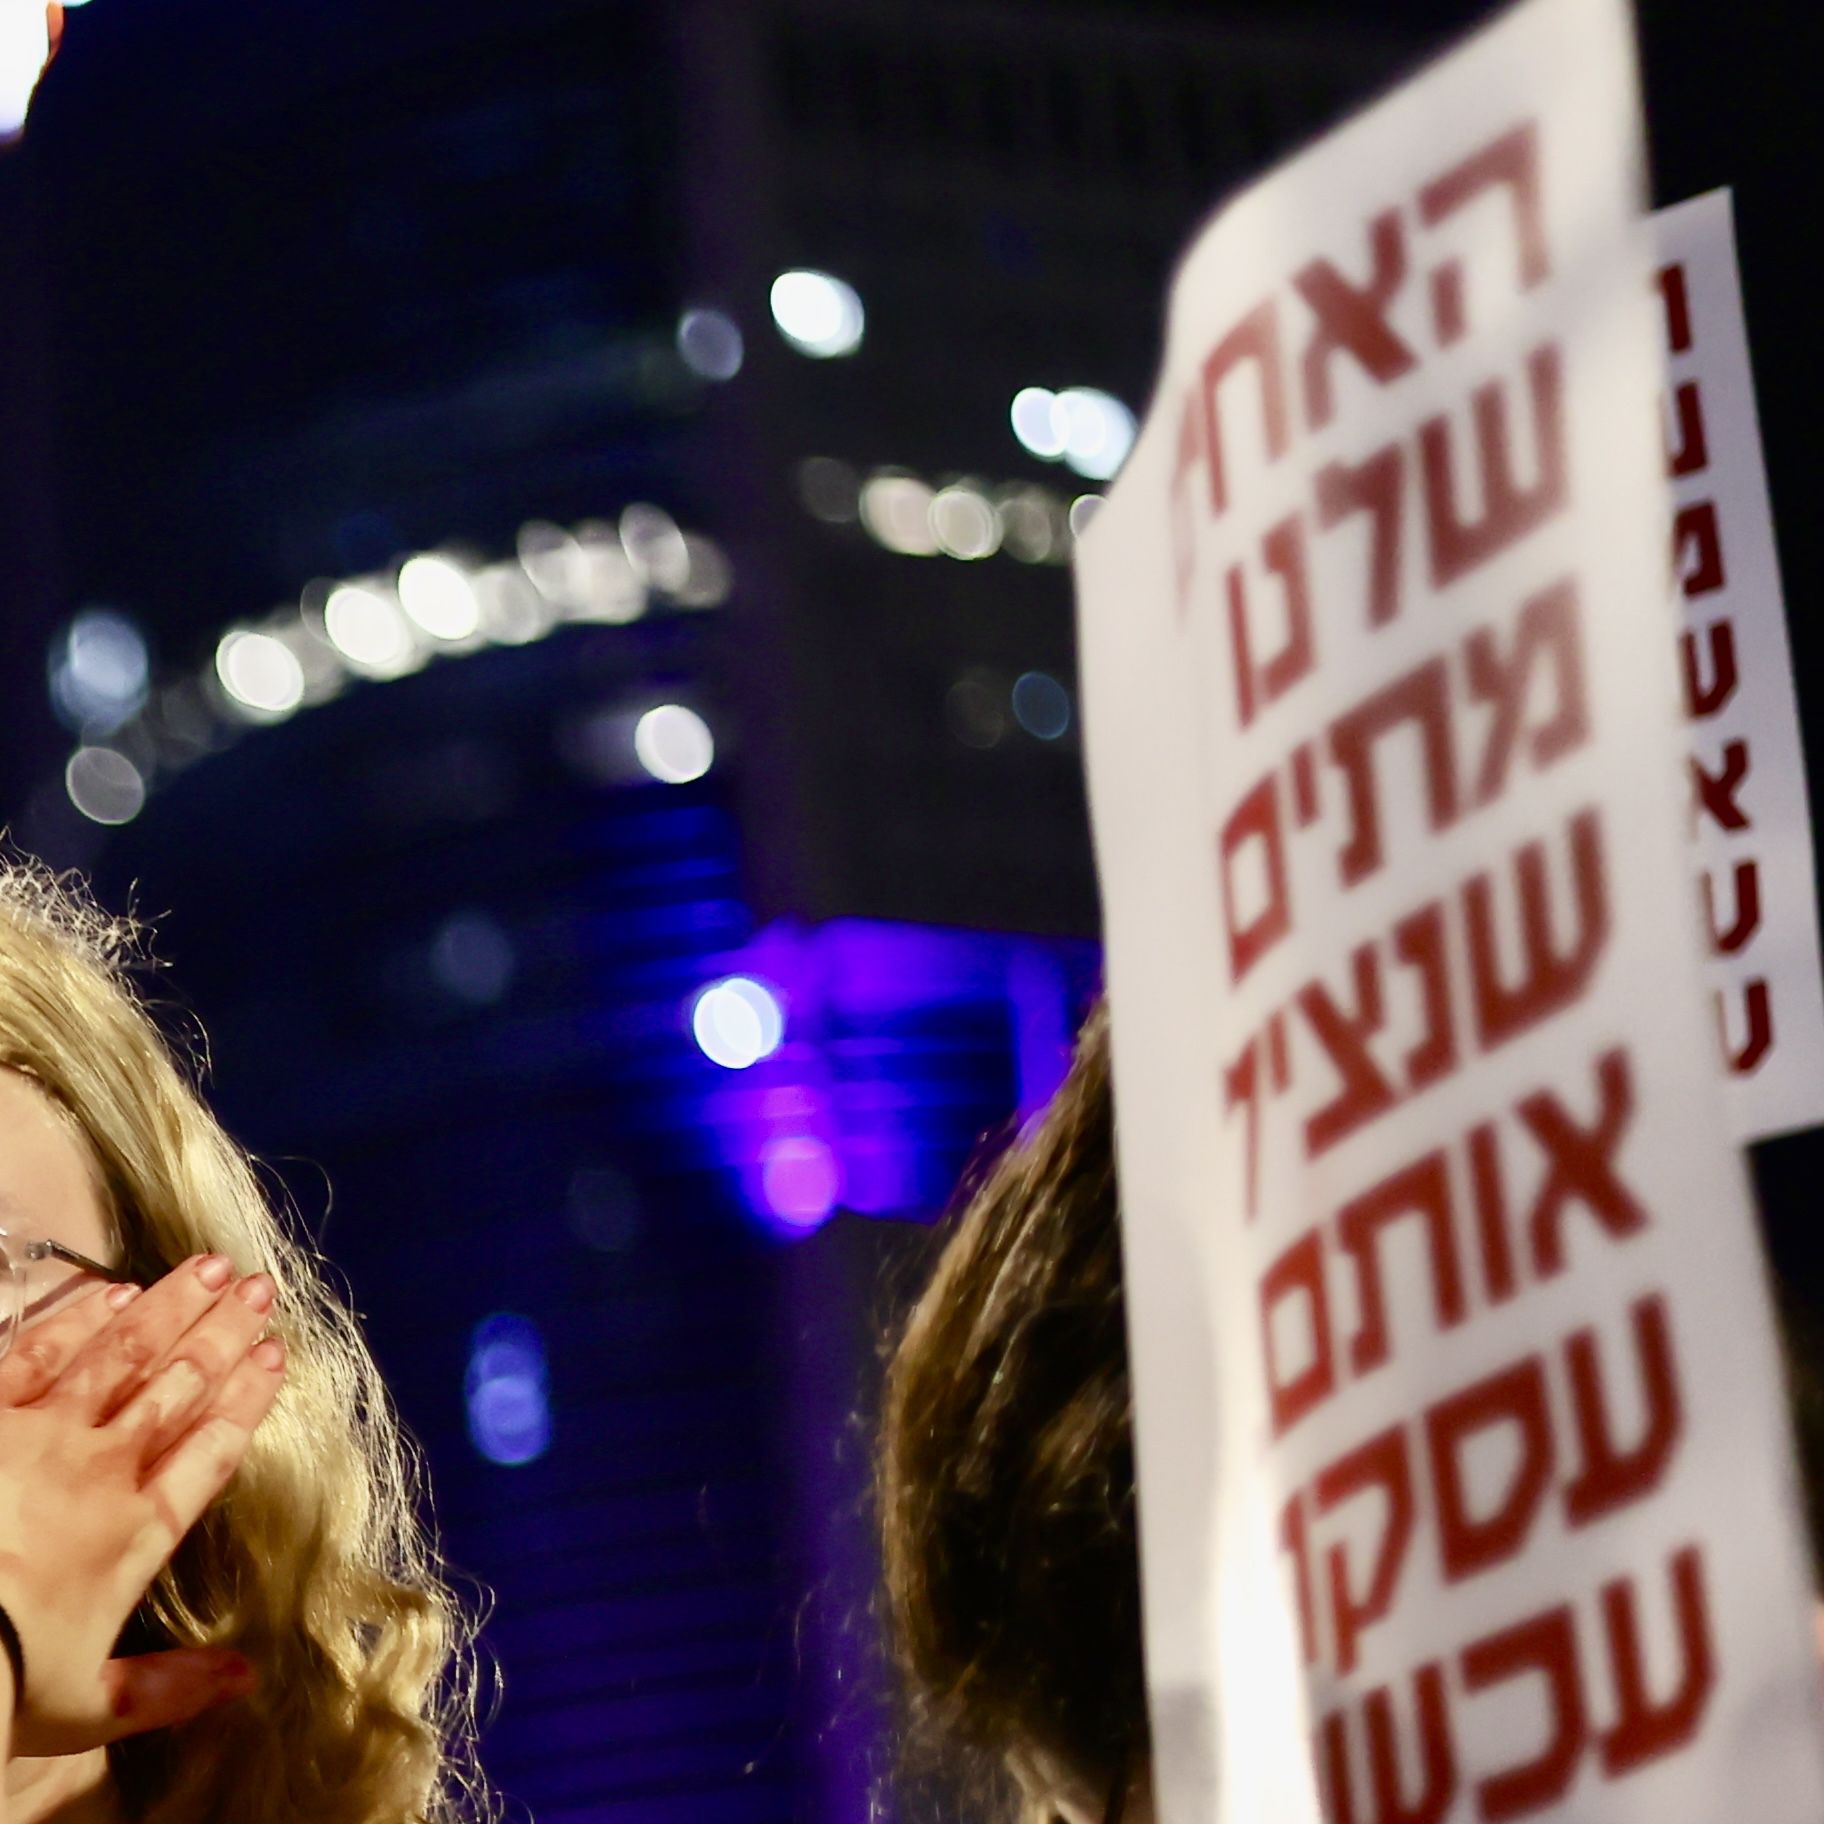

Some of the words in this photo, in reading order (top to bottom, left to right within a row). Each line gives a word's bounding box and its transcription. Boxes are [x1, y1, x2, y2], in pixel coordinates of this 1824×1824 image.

[1172, 116, 1549, 625] האח
[1223, 341, 1567, 733] שלנו
[1219, 574, 1590, 985] מתים
[1258, 1042, 1651, 1441] אותם
